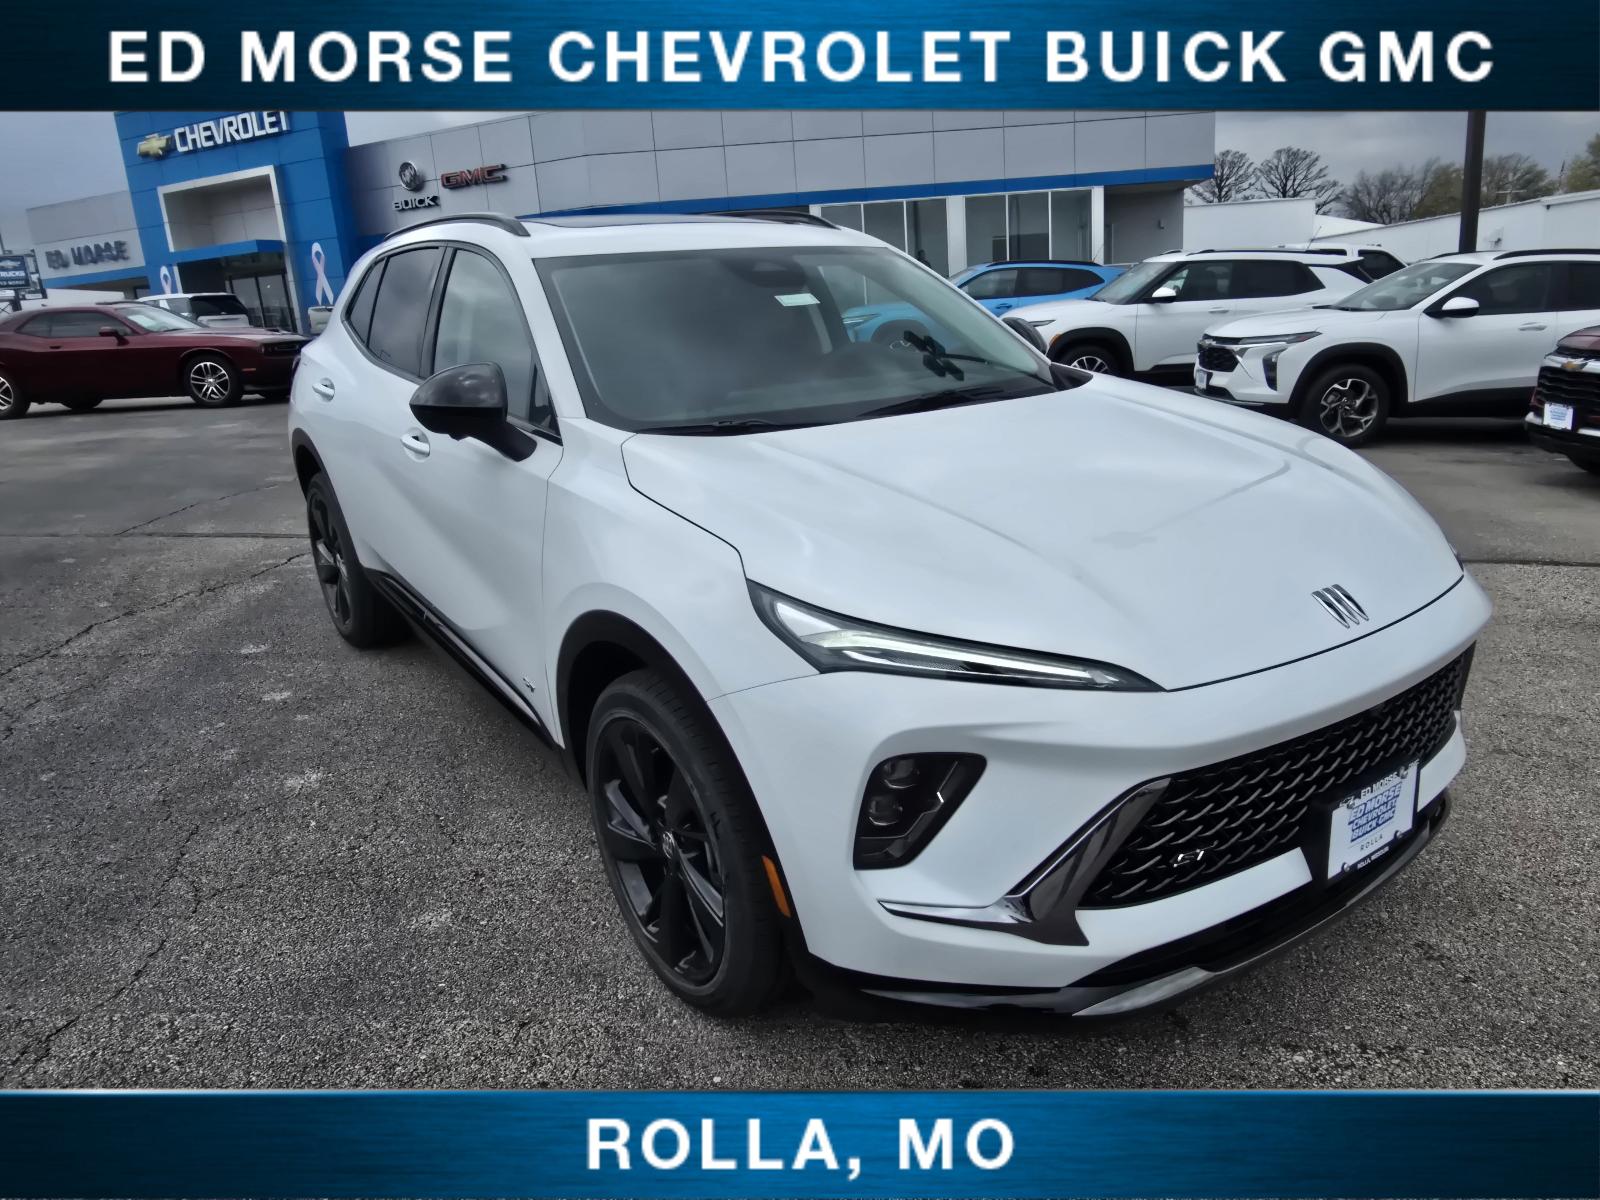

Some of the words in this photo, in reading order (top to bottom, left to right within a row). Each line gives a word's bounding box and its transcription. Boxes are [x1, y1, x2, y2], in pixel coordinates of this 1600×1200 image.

[174, 111, 287, 152] CHEVROLET
[441, 164, 505, 188] GMC
[393, 196, 435, 210] BUICK
